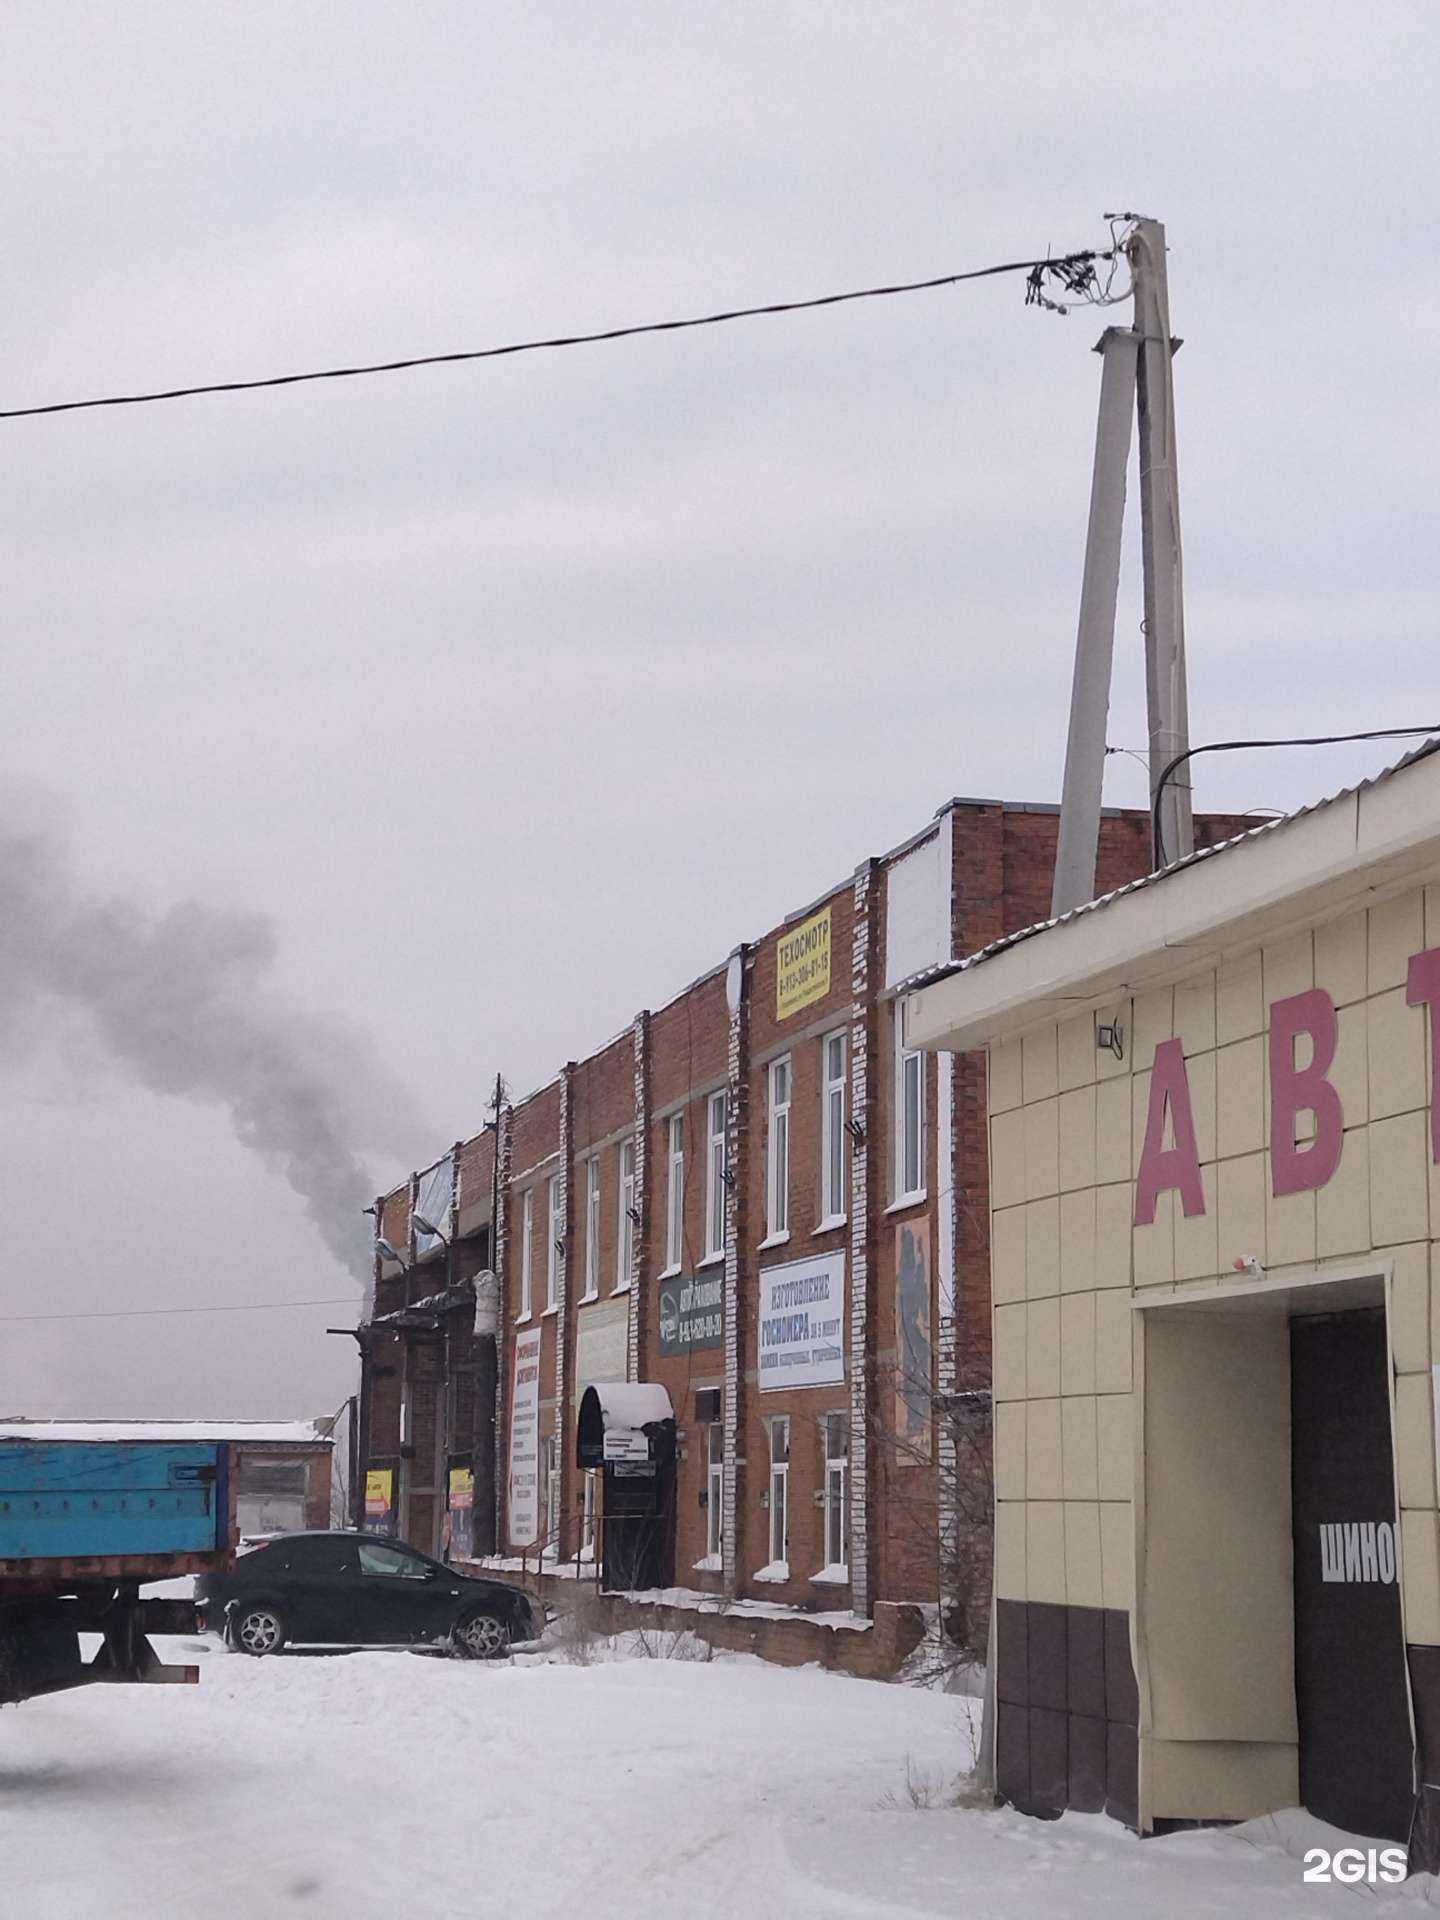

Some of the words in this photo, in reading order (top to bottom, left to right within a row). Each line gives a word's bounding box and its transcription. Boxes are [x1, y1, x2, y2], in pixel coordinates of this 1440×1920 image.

[779, 919, 829, 970] ТЕХОСМОТР
[771, 1274, 830, 1311] ИЗГОТОВЛЕНИЕ
[762, 1312, 809, 1347] ГОСНОМЕРА
[1320, 1522, 1400, 1584] ШИНО
